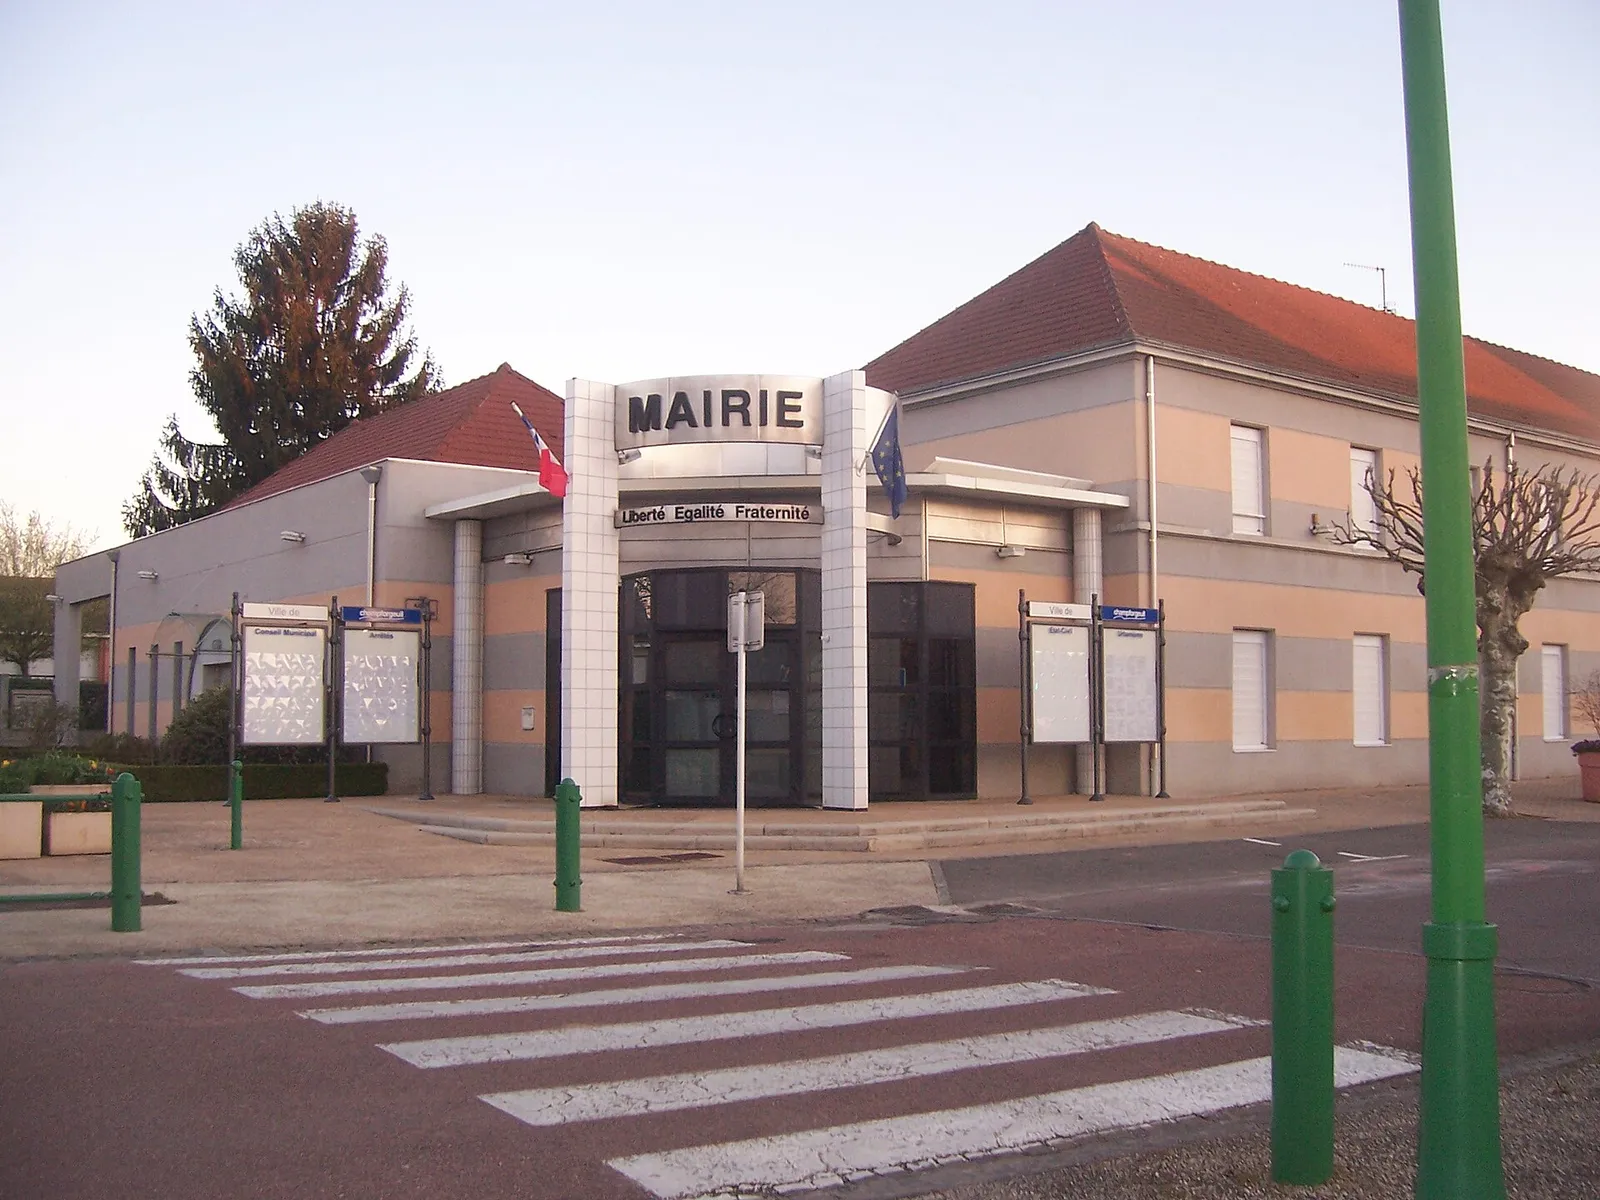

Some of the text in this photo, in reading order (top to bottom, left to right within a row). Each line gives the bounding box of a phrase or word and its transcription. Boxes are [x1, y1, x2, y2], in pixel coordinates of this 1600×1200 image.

[628, 389, 804, 433] MAIRIE
[622, 504, 809, 523] Liberté Egalité Fraternité
[268, 606, 300, 617] Ville de
[1049, 606, 1063, 616] Ville
[254, 628, 282, 637] Conseil
